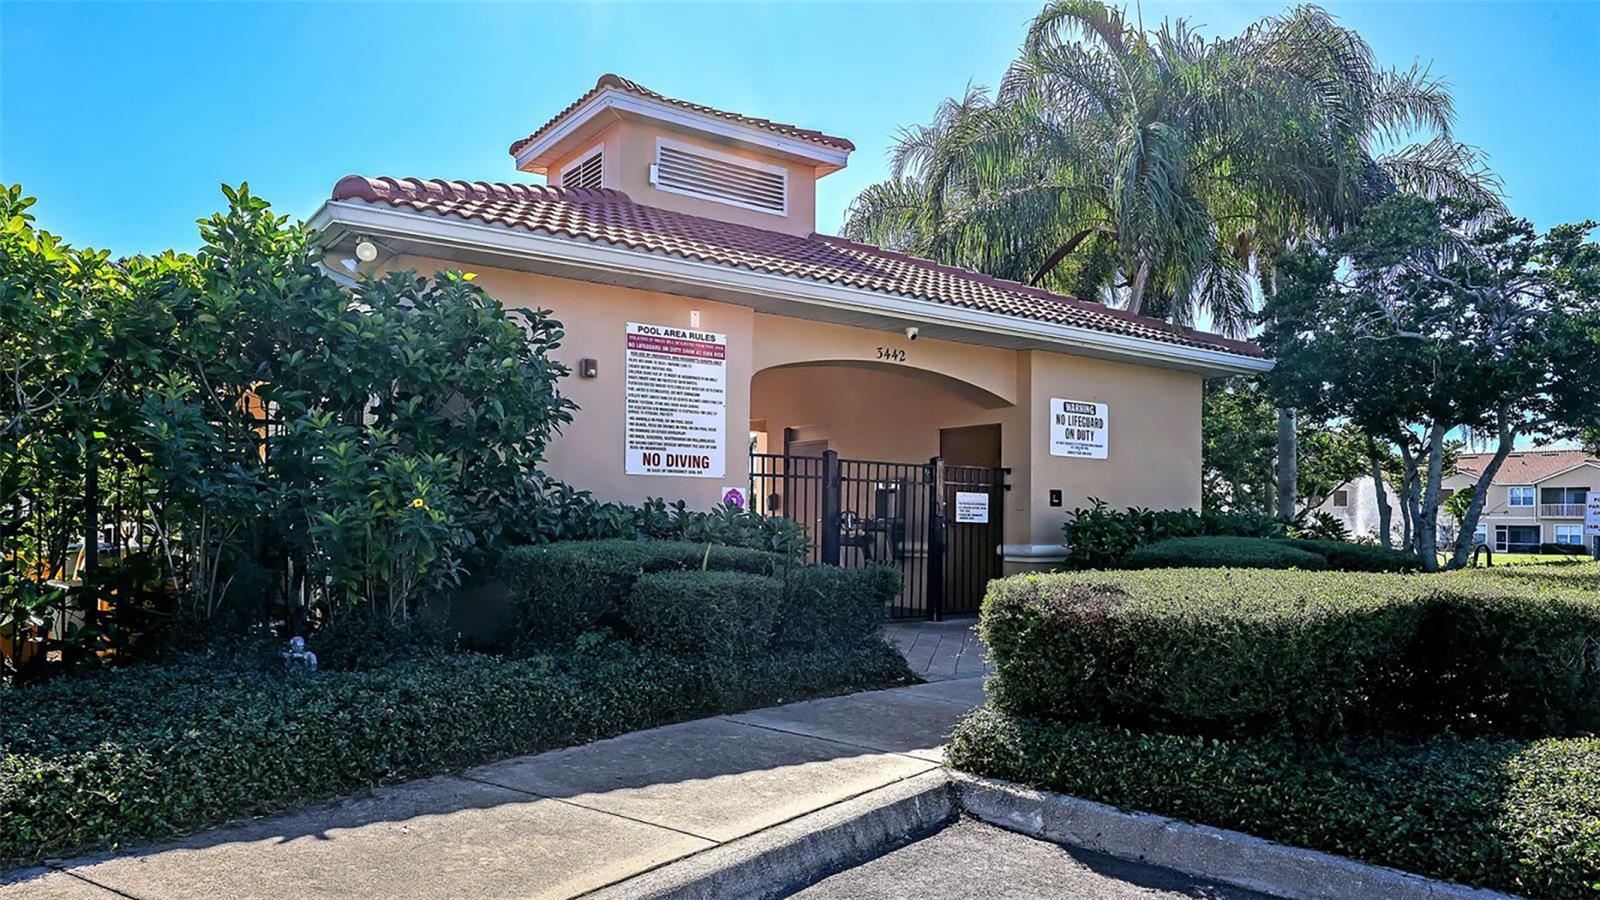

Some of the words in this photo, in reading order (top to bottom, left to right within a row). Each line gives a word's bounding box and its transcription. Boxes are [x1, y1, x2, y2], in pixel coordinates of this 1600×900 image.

[637, 325, 661, 335] POOL
[663, 329, 687, 339] AREA
[689, 333, 716, 342] RULES
[876, 347, 906, 361] 3442
[1065, 402, 1095, 415] WARNING
[1056, 414, 1066, 425] NO
[1068, 415, 1104, 429] LIFEGUARD
[1065, 428, 1075, 440] ON
[1077, 429, 1095, 441] DUTY
[642, 453, 661, 467] NO
[666, 453, 710, 469] DIVING
